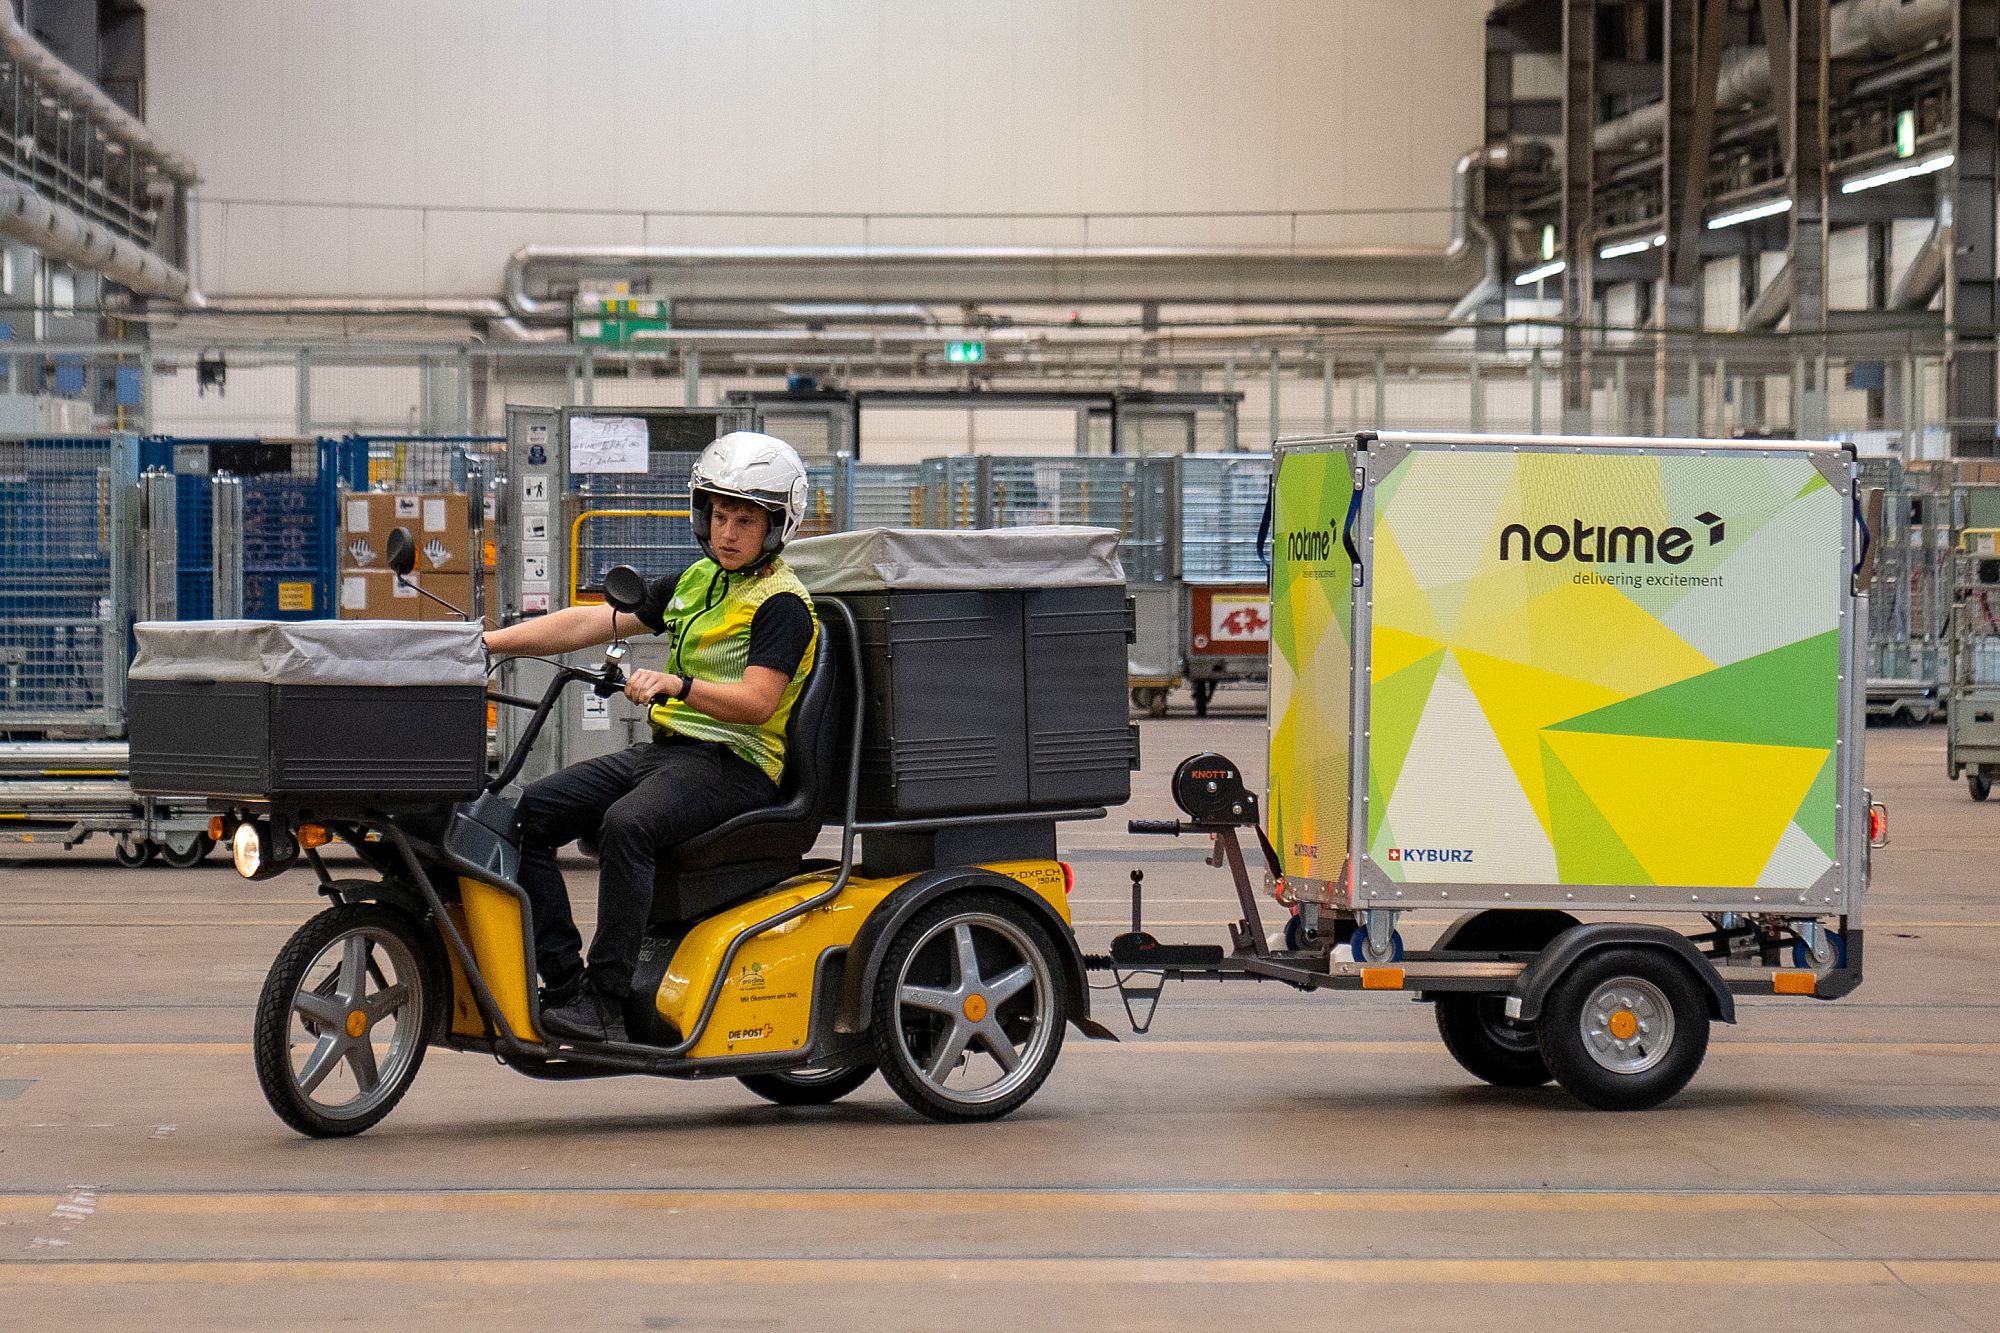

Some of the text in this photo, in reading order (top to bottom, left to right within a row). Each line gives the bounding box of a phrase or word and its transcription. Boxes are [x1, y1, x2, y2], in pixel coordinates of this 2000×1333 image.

[1287, 526, 1330, 561] notime
[1499, 518, 1694, 564] notime
[1573, 572, 1723, 588] delivering excitement
[1191, 771, 1226, 779] KNOTT
[1404, 848, 1473, 862] KYBURZ
[728, 1028, 763, 1039] DIE POST
